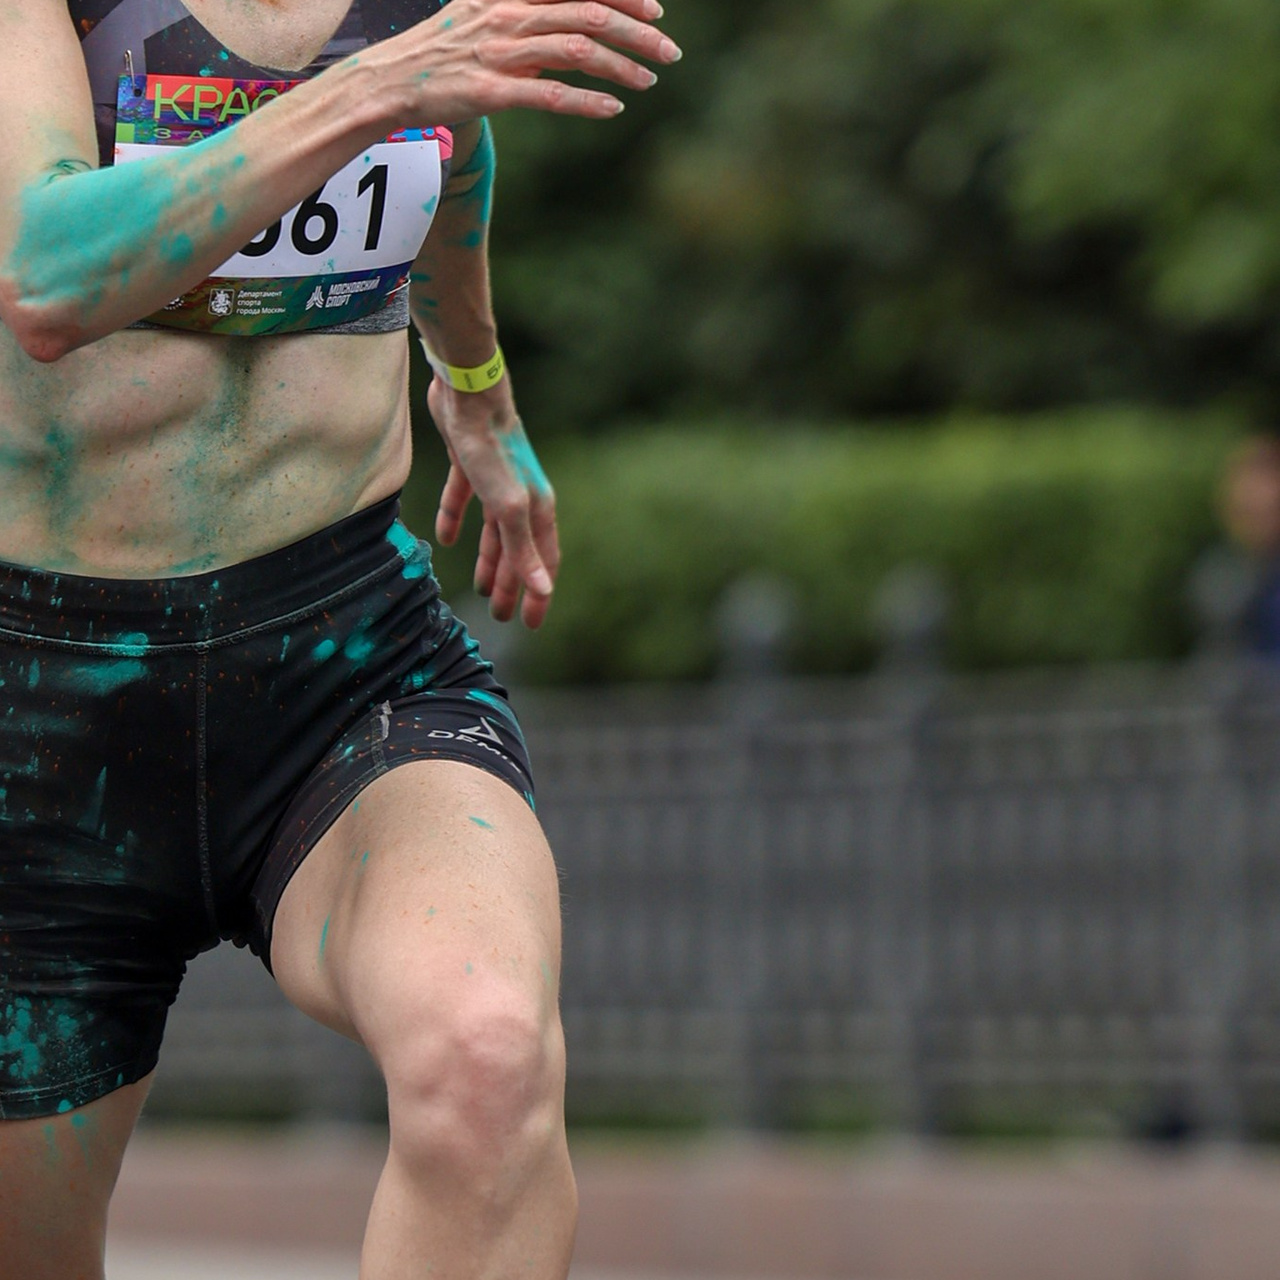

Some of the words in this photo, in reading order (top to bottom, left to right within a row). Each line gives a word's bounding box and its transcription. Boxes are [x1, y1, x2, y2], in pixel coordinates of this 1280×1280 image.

[328, 276, 381, 295] МОСКОВСКИЙ
[237, 290, 283, 299] Департамент
[325, 294, 352, 308] СПОРТ
